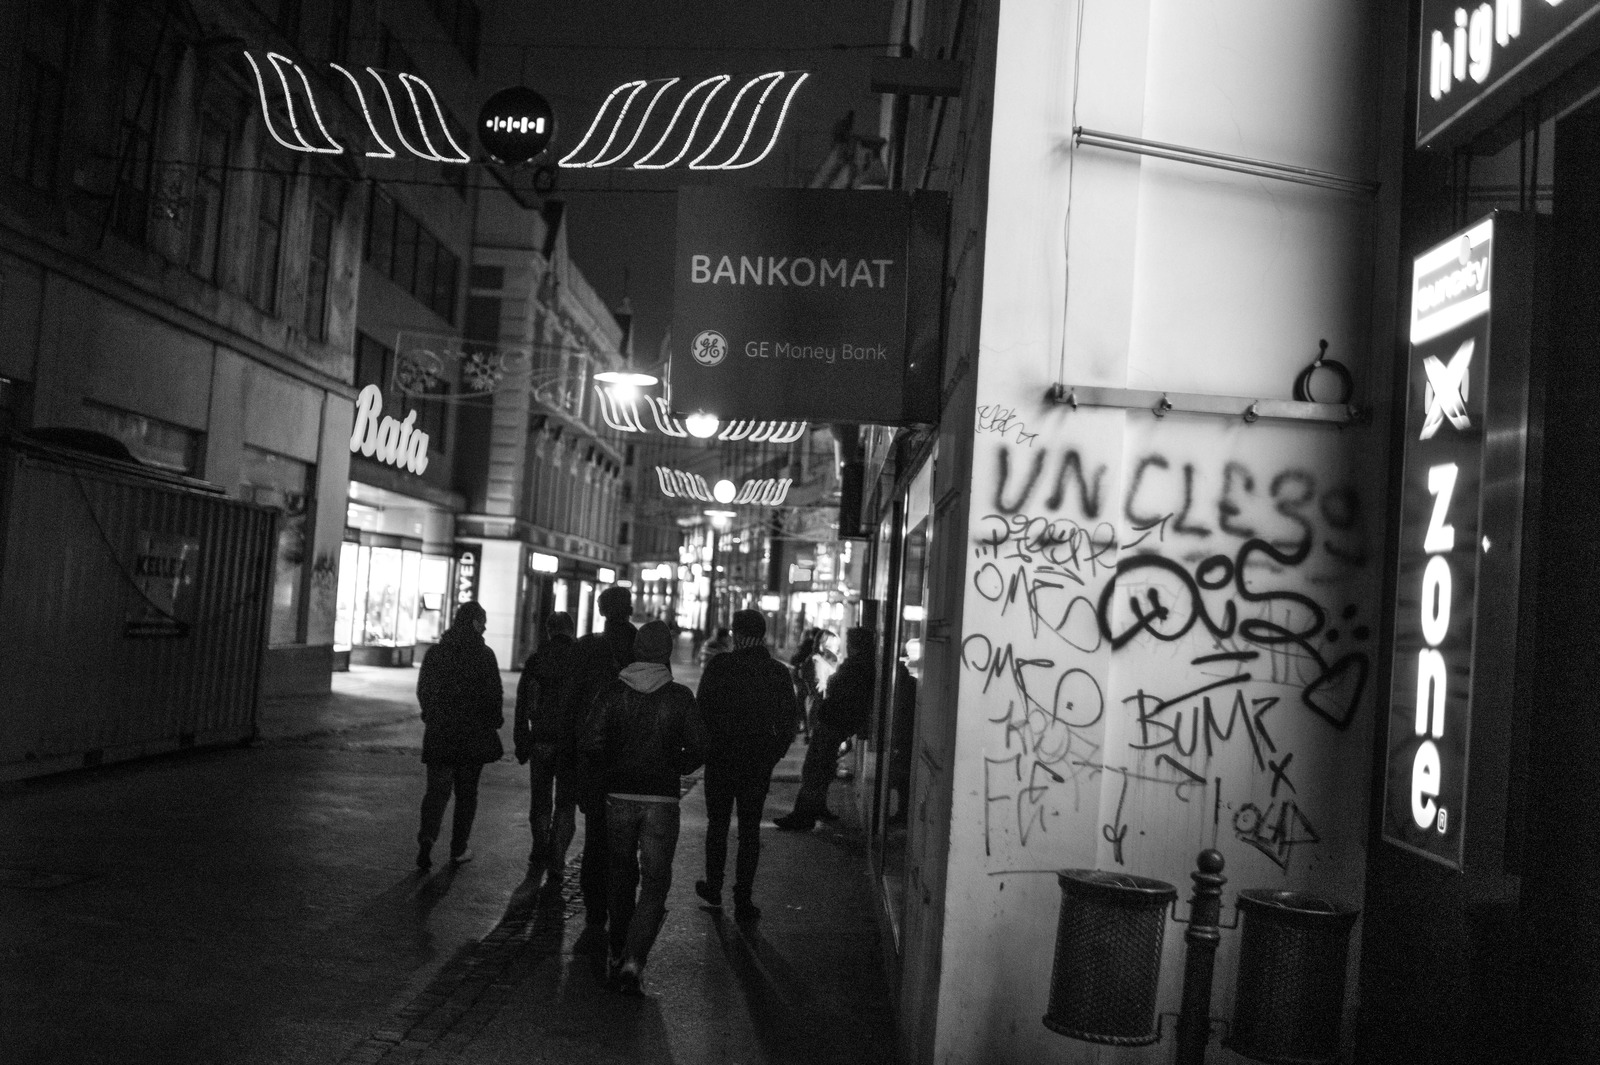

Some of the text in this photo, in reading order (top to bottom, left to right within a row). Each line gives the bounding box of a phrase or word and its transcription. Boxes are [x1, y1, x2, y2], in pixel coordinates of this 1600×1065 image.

[691, 254, 894, 289] BANKOMAT
[745, 341, 888, 364] GE Money Bank
[457, 552, 476, 606] RVED
